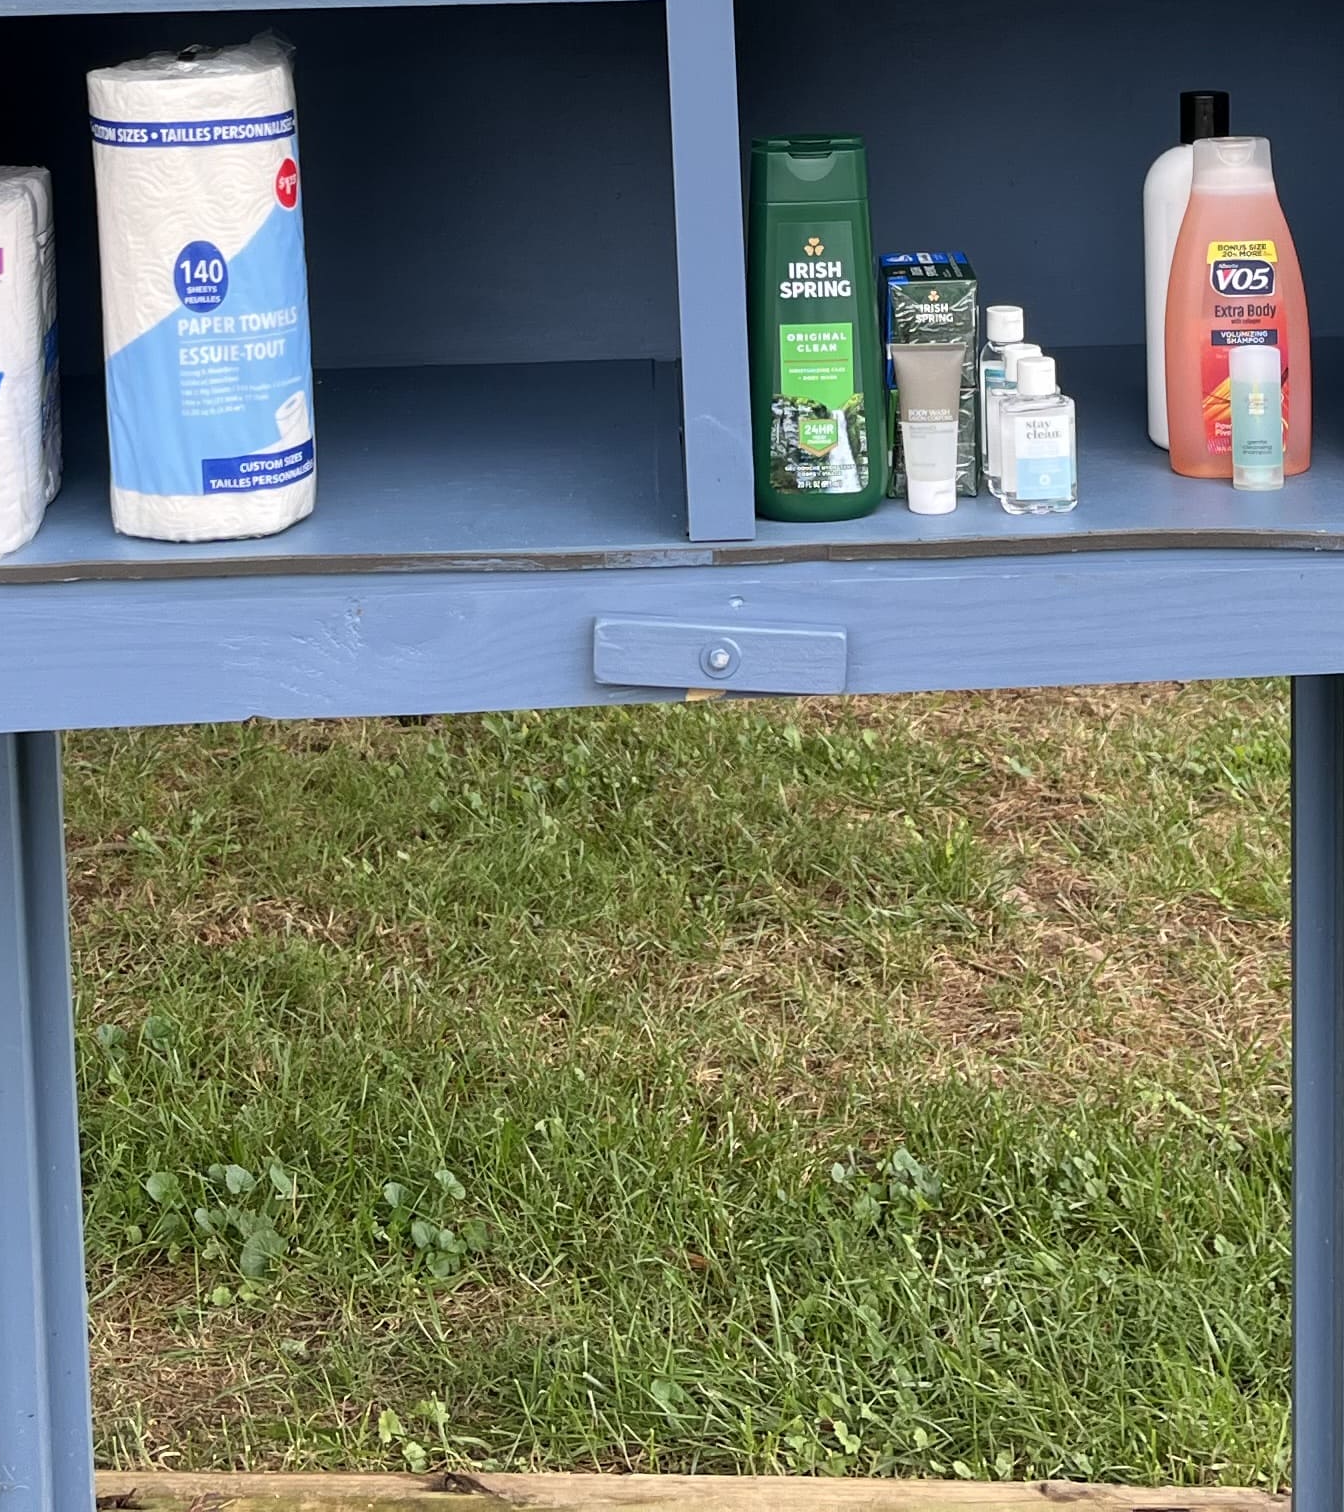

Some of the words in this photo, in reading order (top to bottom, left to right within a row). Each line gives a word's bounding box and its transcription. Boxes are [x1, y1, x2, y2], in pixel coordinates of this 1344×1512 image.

[117, 127, 149, 143] SIZES
[160, 126, 211, 143] TAILLES
[1248, 243, 1267, 251] SIZE
[179, 259, 224, 284] 140
[788, 261, 842, 279] IRISH
[1216, 267, 1270, 290] VO5
[186, 285, 218, 294] SHEETS
[779, 280, 852, 299] SPRING
[184, 295, 221, 305] FEUILLES
[920, 303, 949, 313] IRISH
[1214, 305, 1245, 318] Extra
[1247, 303, 1277, 319] Body
[178, 316, 236, 337] PAPER
[239, 306, 297, 333] TOWELS
[915, 313, 954, 323] SPRING
[786, 332, 847, 342] ORIGINAL
[1220, 330, 1268, 338] VOLUMIZING
[179, 339, 287, 366] ESSUIE-TOUT
[796, 343, 838, 353] CLEAN
[804, 423, 835, 435] 24HR
[1025, 419, 1052, 430] stay
[239, 459, 284, 473] CUSTOM
[283, 451, 303, 466] SIZES
[209, 478, 252, 489] TAILLES
